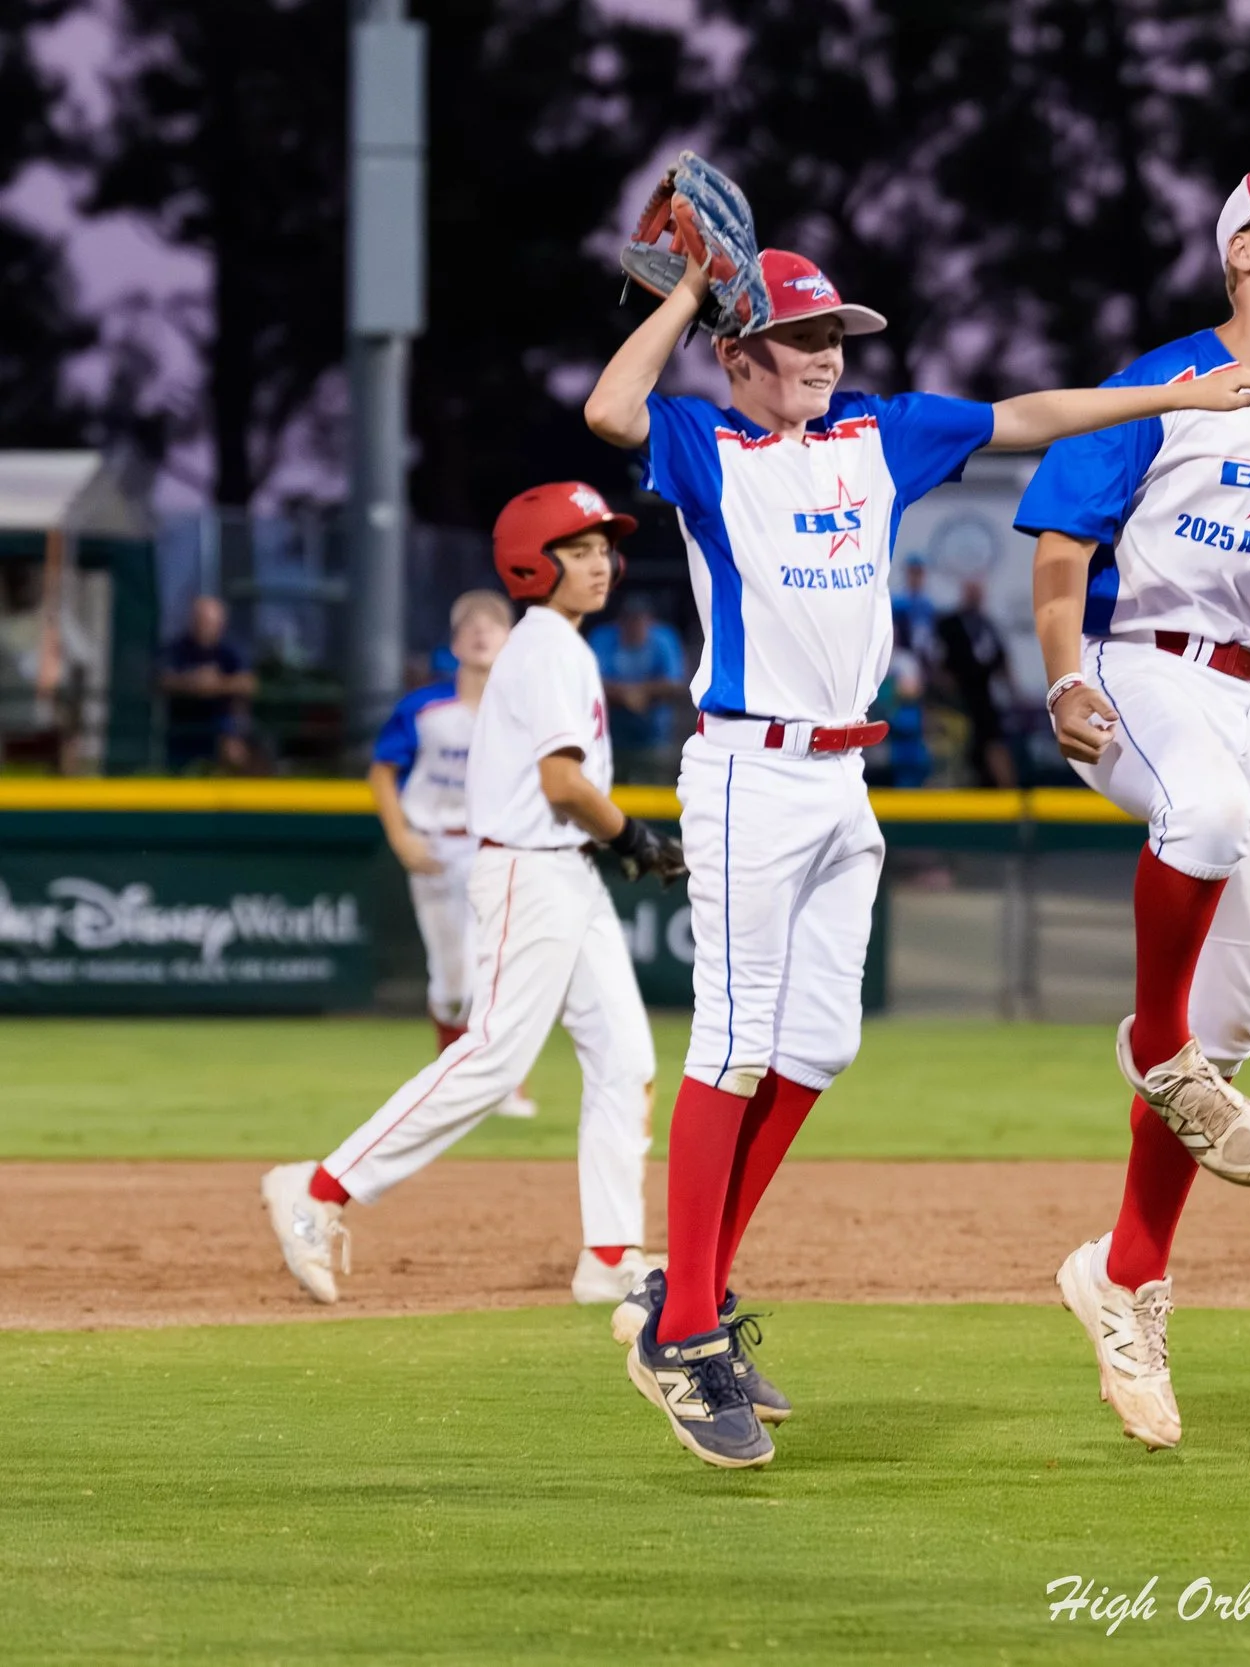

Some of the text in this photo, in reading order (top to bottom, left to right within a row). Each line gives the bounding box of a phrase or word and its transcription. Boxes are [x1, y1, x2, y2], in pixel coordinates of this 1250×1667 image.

[793, 508, 861, 534] BLS
[1175, 513, 1234, 551] 2025
[780, 565, 828, 588] 2025
[831, 567, 852, 588] ALL
